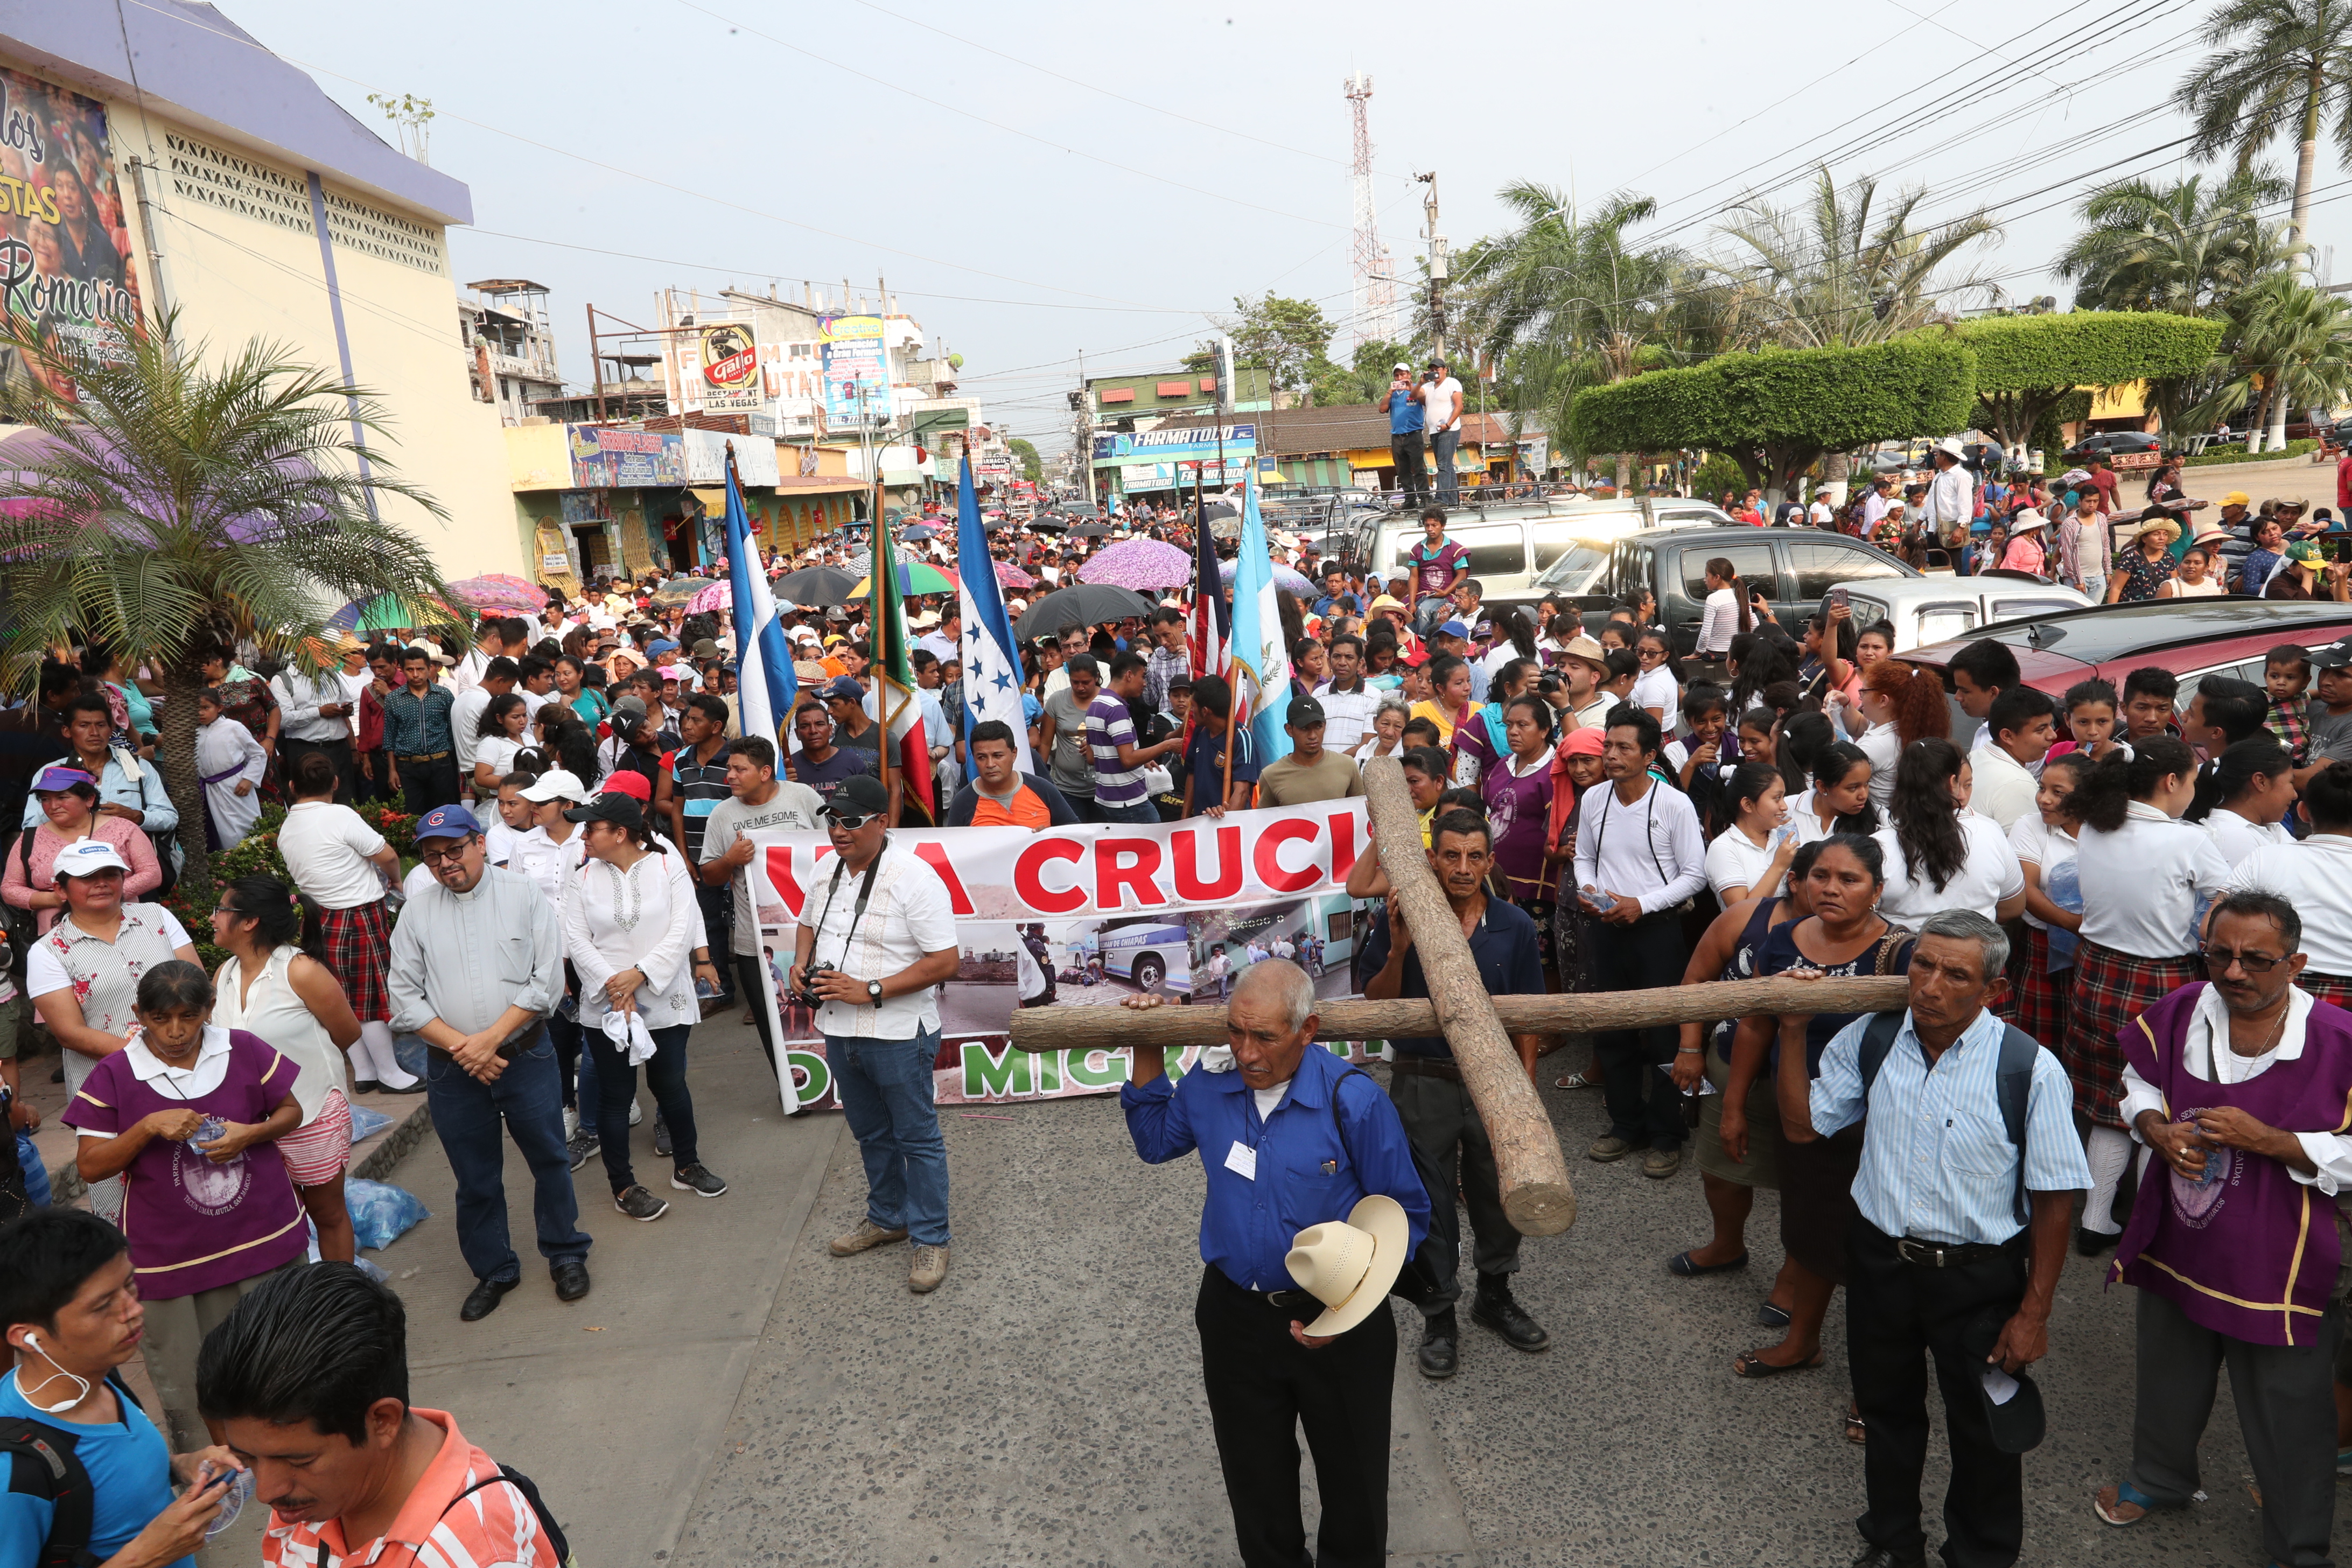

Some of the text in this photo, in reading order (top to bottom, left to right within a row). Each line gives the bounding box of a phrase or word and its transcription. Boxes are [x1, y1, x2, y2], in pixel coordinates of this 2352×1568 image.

[832, 324, 880, 336] Creativa
[88, 343, 107, 359] Tres
[830, 339, 879, 350] Sublimación
[827, 348, 883, 359] a Gran Formato
[709, 398, 758, 409] LAS VEGAS
[1133, 426, 1235, 447] FARMATODO
[1188, 440, 1236, 449] FARMACIAS
[1123, 478, 1173, 490] FARMATODO
[429, 812, 445, 826] C
[733, 811, 799, 831] GIVE ME SOME
[1014, 811, 1375, 913] CRUCI
[1121, 934, 1148, 947] CHIAPAS
[172, 1140, 185, 1187] PARROQUIA
[183, 1172, 253, 1217] TECÚN UMÁN, AYUTLA, SAN MARCOS
